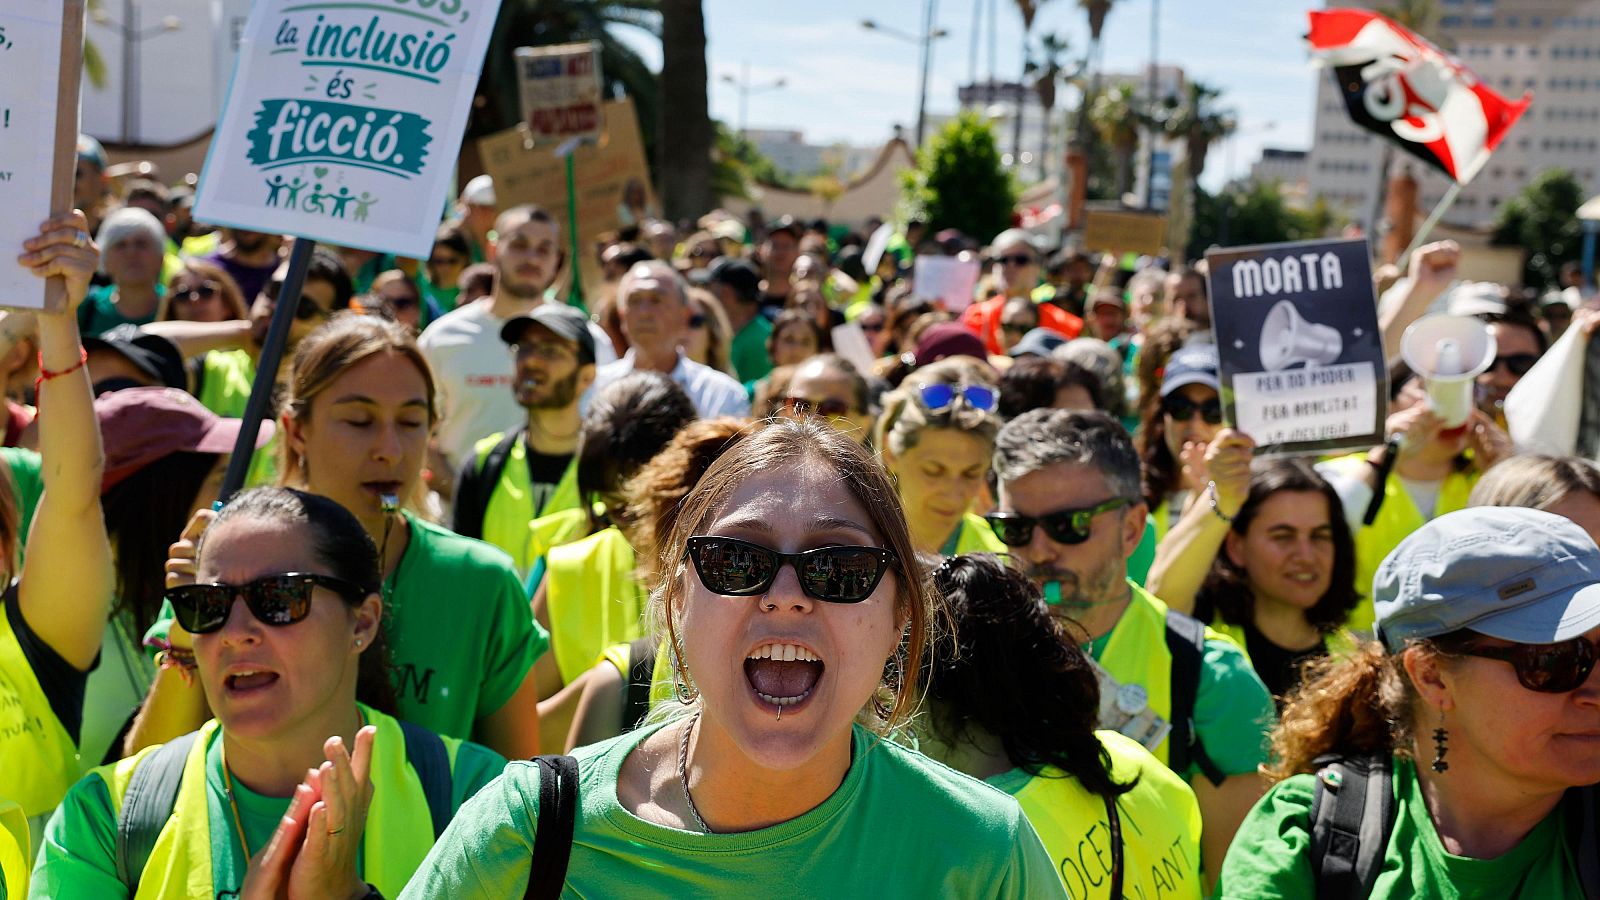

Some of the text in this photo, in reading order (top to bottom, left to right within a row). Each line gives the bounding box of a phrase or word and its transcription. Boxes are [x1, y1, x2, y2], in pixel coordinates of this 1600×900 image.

[275, 14, 457, 73] la inclusió
[326, 70, 354, 99] és
[268, 101, 404, 164] ficció.
[1232, 252, 1343, 298] MORTA
